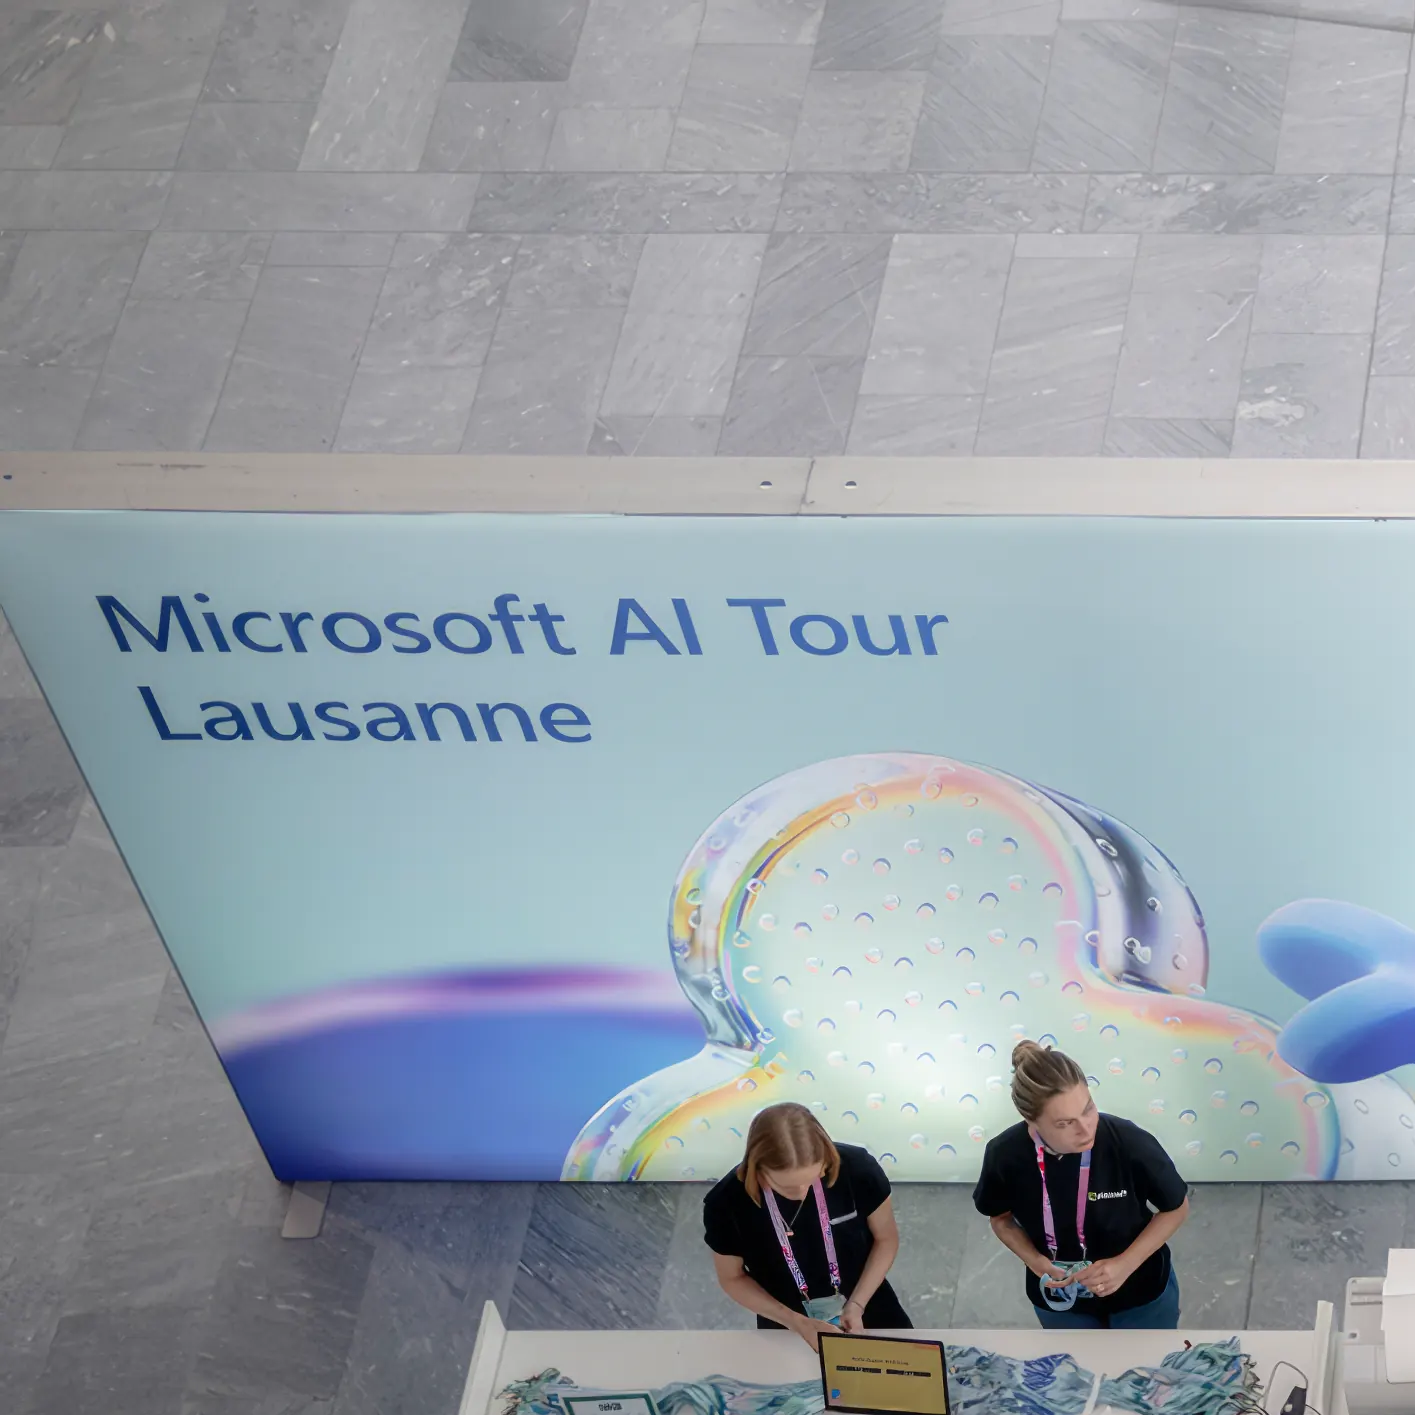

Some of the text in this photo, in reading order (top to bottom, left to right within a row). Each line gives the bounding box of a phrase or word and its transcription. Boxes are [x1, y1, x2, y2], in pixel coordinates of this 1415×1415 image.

[95, 593, 949, 656] Microsoft AI Tour
[137, 686, 591, 743] Lausanne
